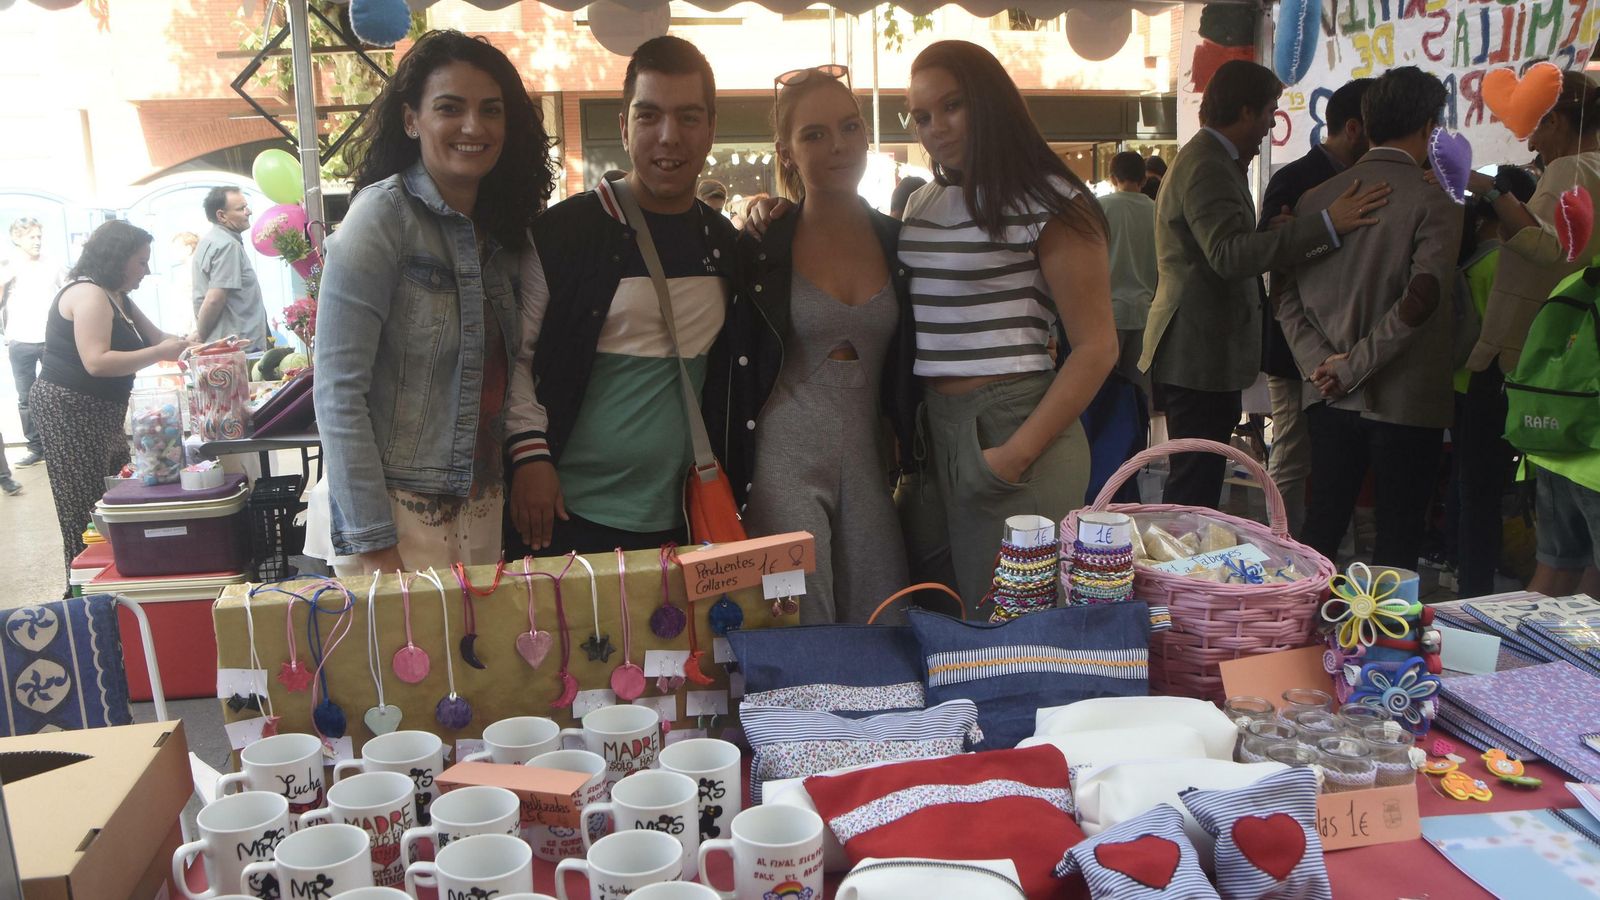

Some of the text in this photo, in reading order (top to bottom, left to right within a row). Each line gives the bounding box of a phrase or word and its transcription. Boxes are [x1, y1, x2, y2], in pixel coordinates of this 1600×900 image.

[1524, 415, 1559, 430] RAFA
[1035, 529, 1047, 543] 1€
[1095, 524, 1114, 545] 1€
[695, 556, 755, 579] Pendientes
[696, 576, 738, 594] Collares
[603, 731, 658, 761] MADRE
[276, 768, 321, 799] Lucha
[344, 802, 412, 836] ADRE
[1315, 800, 1369, 837] las 1€
[757, 857, 767, 867] AL
[770, 859, 796, 868] FINAL
[291, 873, 333, 900] MR
